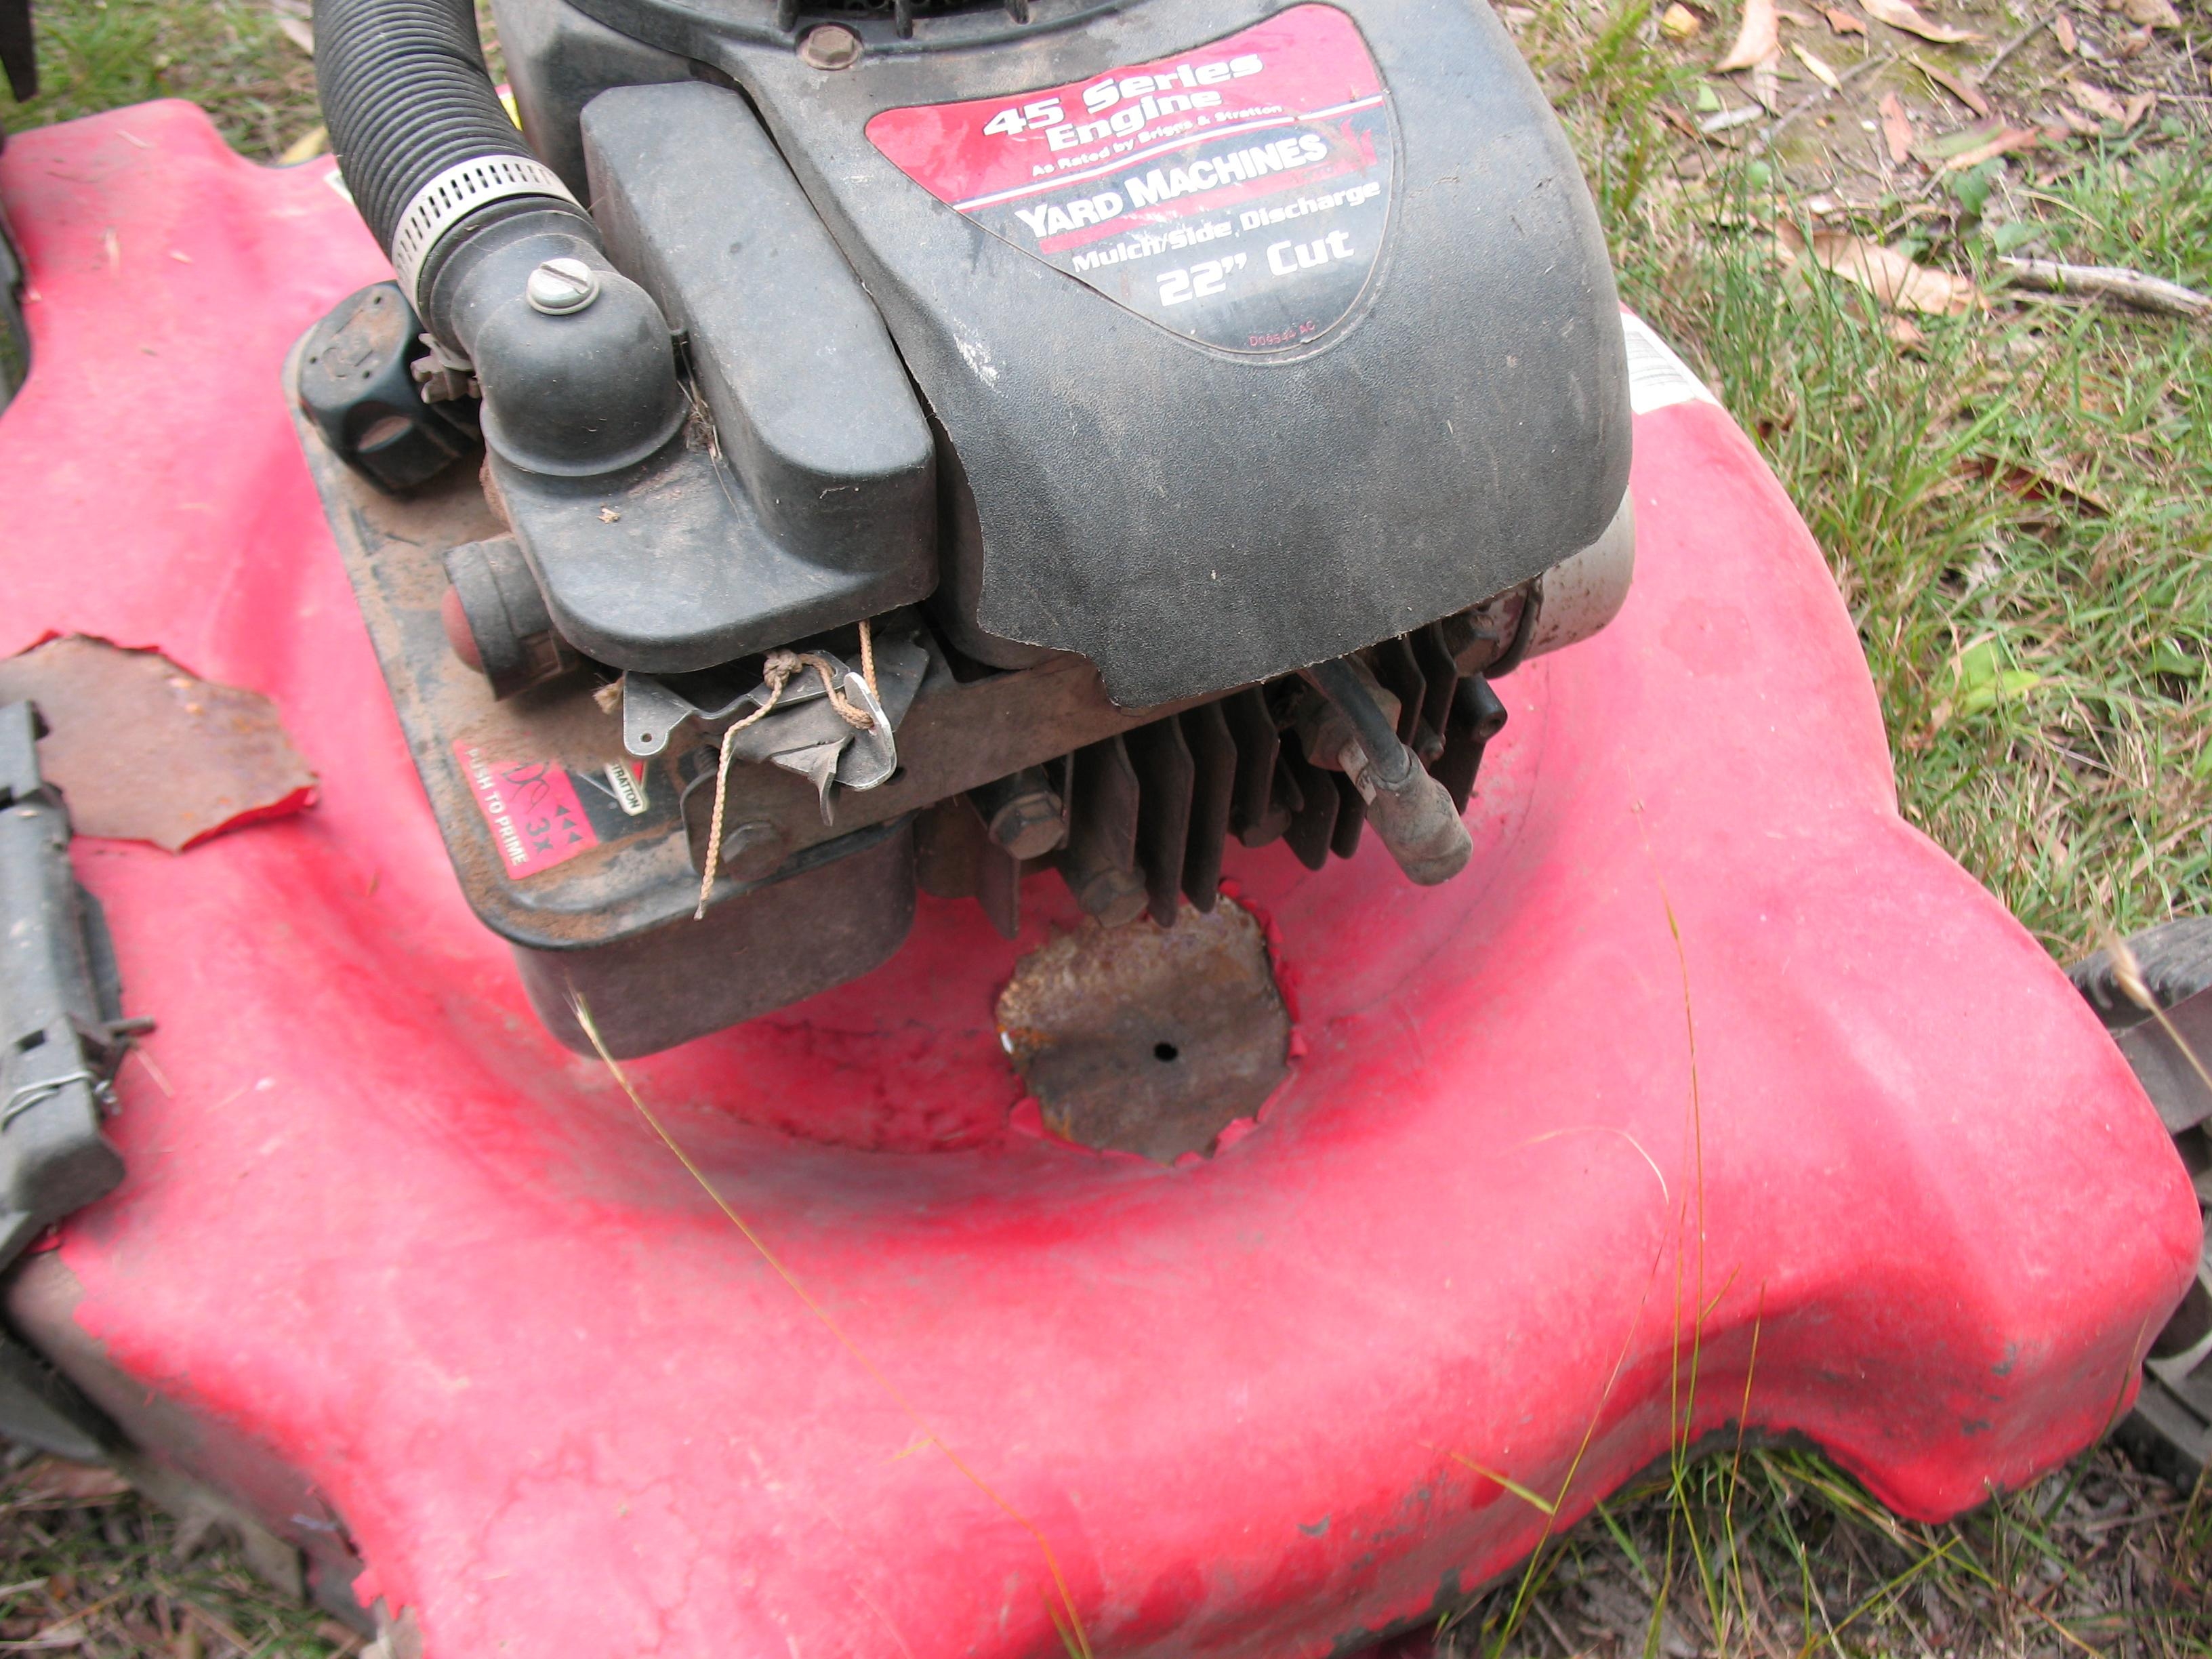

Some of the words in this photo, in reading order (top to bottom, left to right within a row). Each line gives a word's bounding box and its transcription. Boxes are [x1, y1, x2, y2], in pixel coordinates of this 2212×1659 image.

[982, 98, 1065, 136] 45
[1082, 53, 1265, 114] Series
[1044, 89, 1223, 152] Engine
[1032, 164, 1055, 177] As
[1057, 146, 1111, 169] Rated
[1113, 138, 1134, 155] by
[1138, 118, 1193, 144] Briggs
[1197, 114, 1211, 126] &
[1214, 105, 1283, 122] Stratton
[1015, 191, 1124, 239] YARD
[1124, 133, 1328, 209] MACHINES
[1240, 180, 1381, 232] Discharge
[1266, 229, 1355, 276] Cut
[465, 747, 495, 791] PUSH
[484, 789, 506, 814] TO
[494, 815, 530, 867] PRIME
